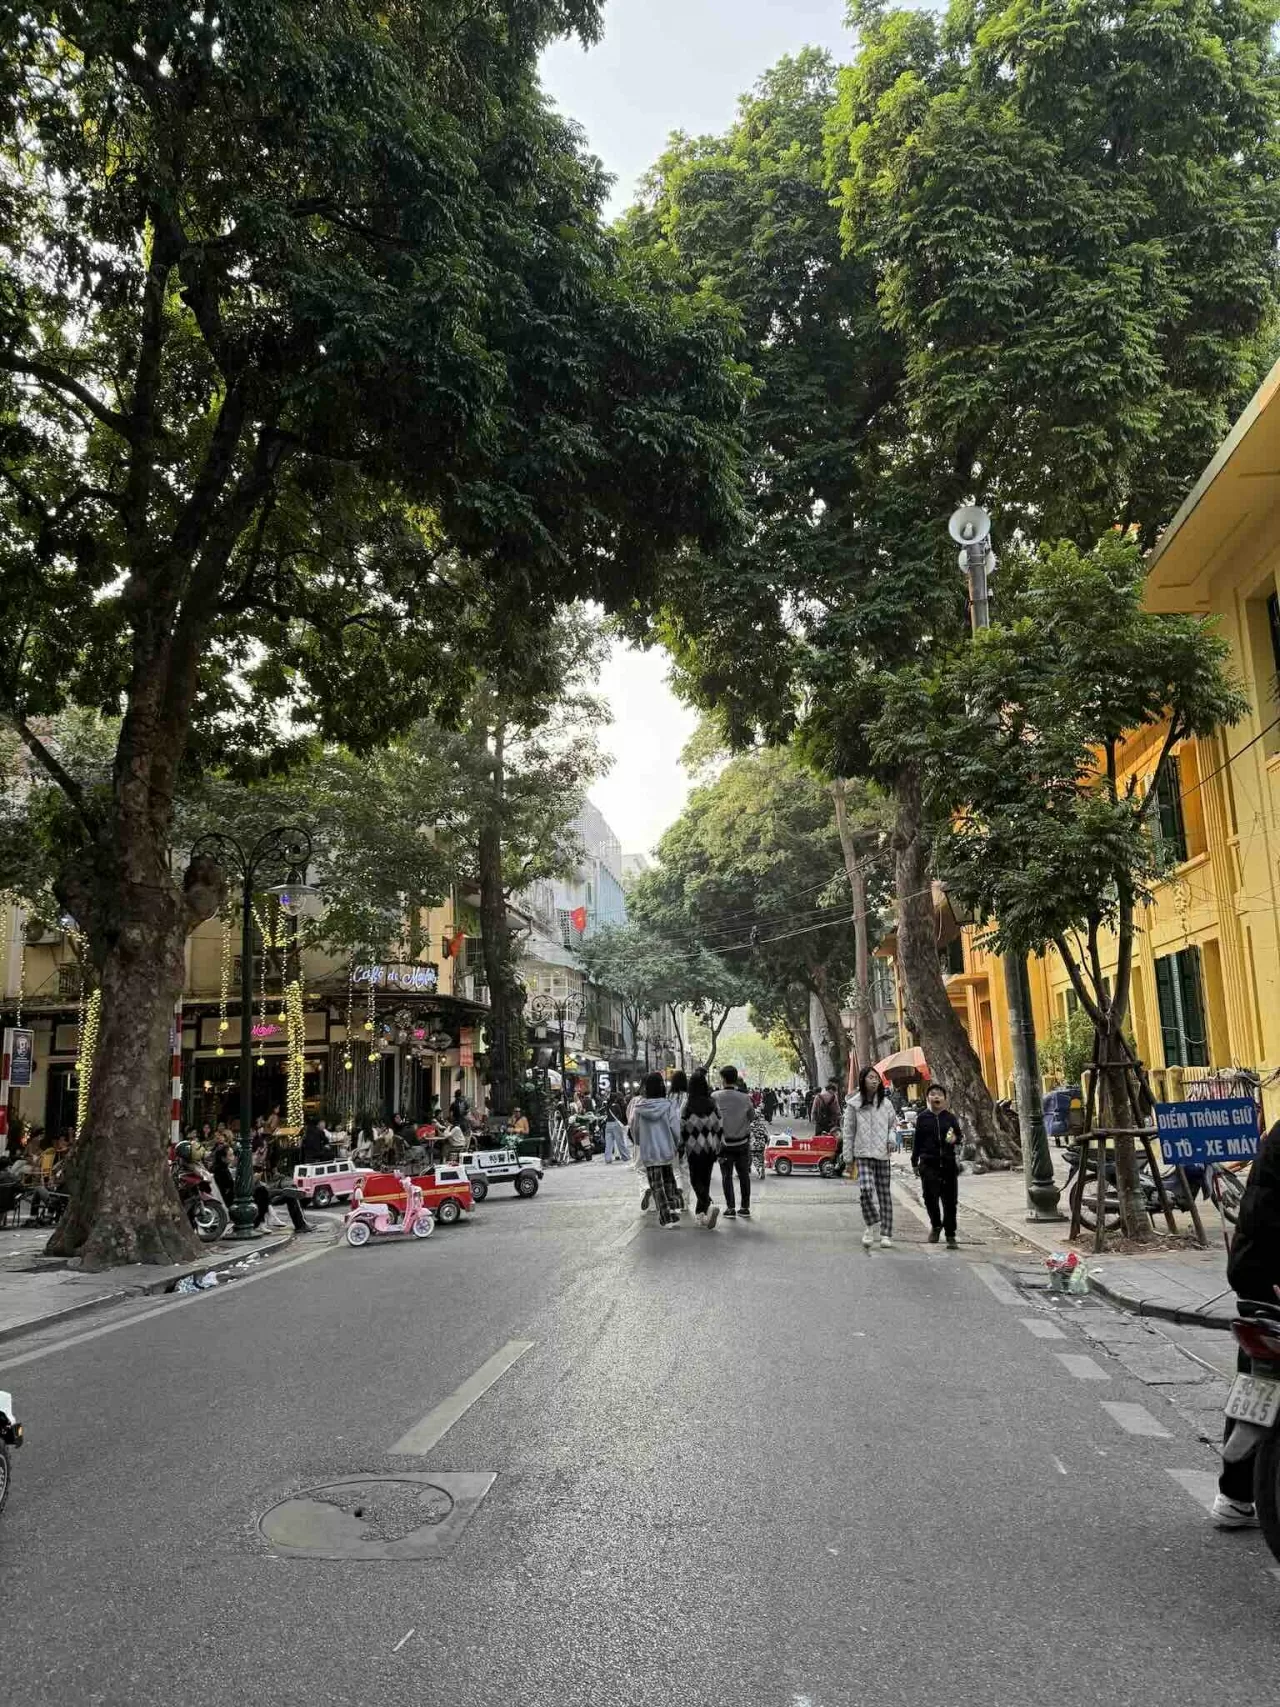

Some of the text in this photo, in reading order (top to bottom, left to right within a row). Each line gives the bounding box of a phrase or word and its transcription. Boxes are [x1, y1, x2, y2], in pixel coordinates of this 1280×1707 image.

[598, 1074, 610, 1089] 5
[1158, 1105, 1253, 1129] ĐIỂM TRÔNG GIỮ
[1162, 1139, 1173, 1158] Ô
[1174, 1138, 1193, 1158] TÔ
[1205, 1139, 1224, 1156] XE
[1226, 1135, 1258, 1155] MÁY
